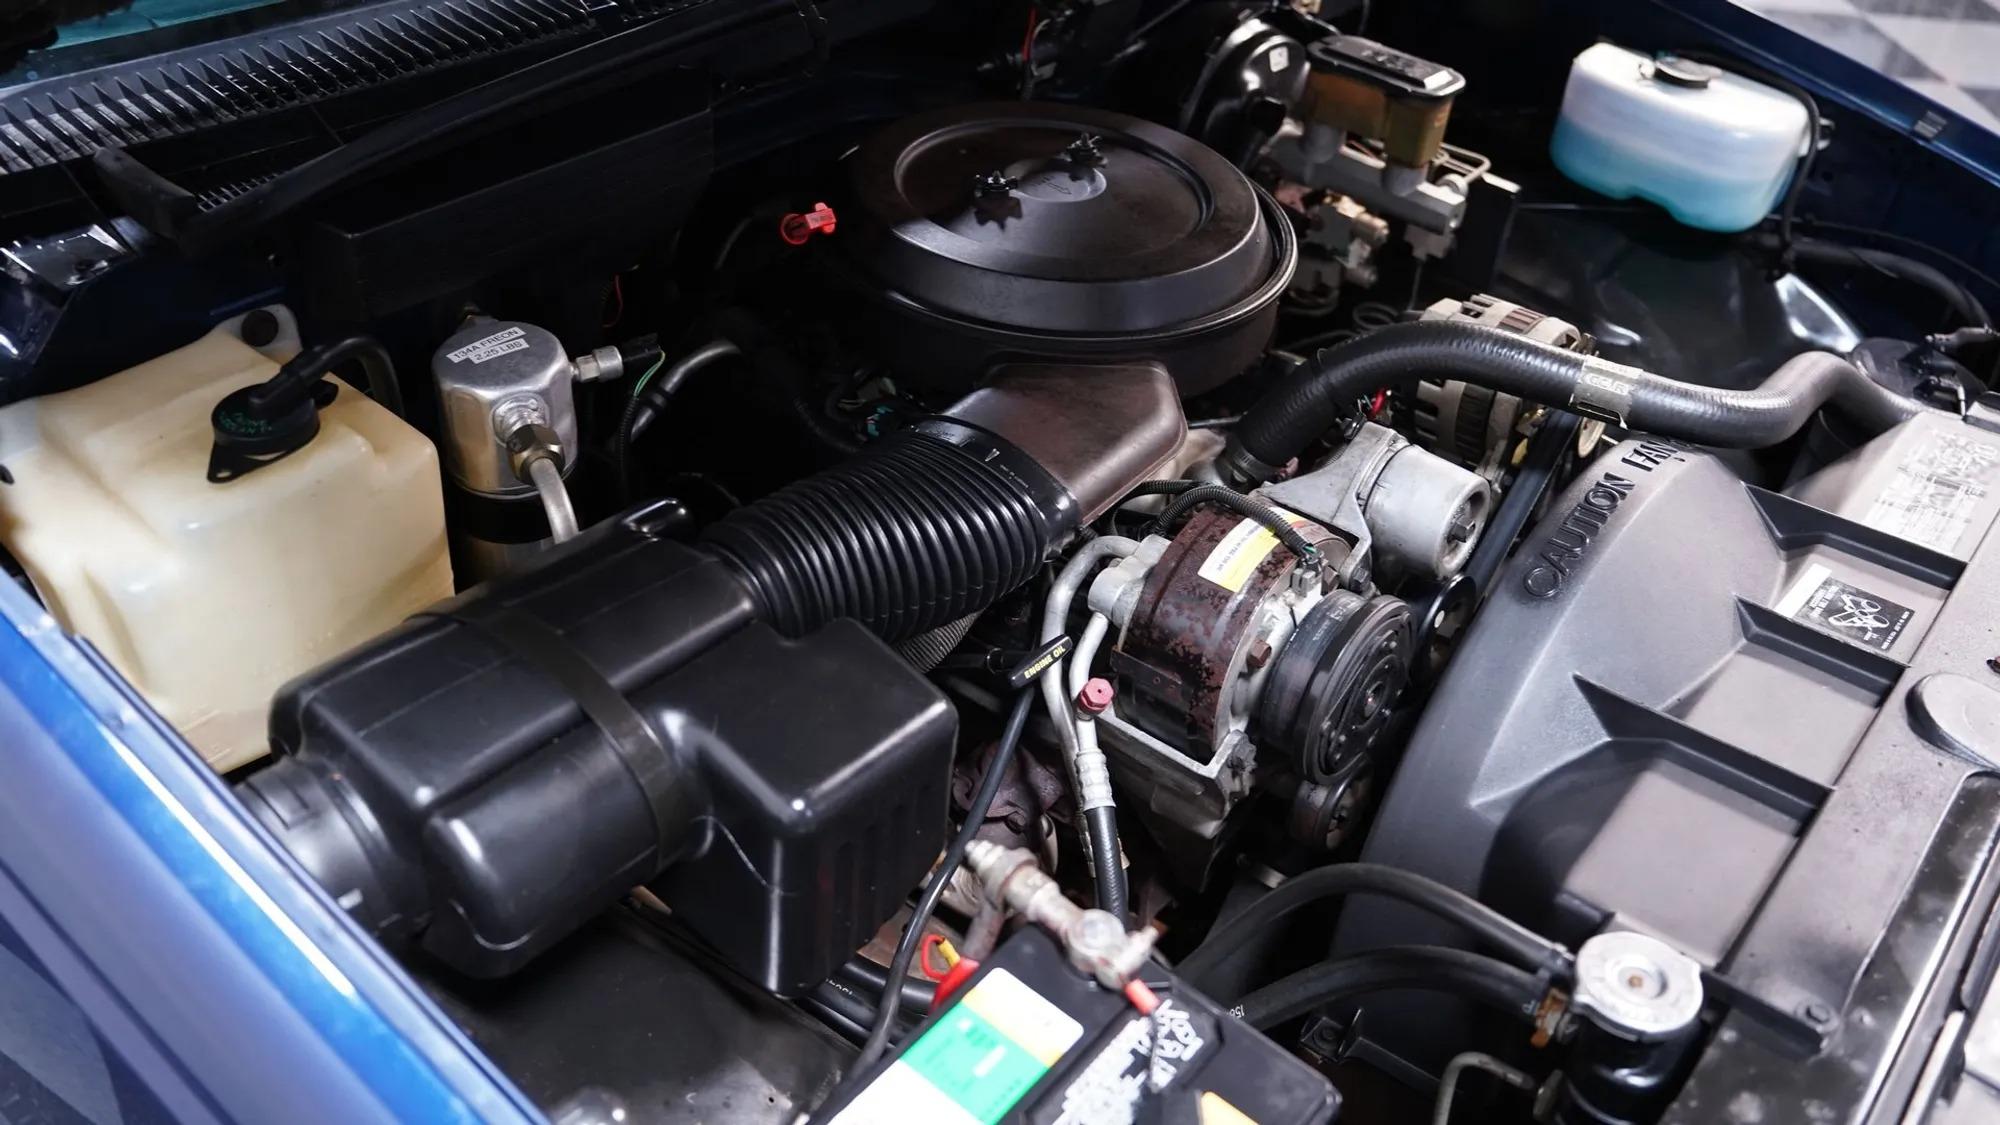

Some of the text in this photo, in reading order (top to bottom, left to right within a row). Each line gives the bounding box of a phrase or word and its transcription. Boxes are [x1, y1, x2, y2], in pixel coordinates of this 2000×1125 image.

[454, 329, 518, 359] 134A FREON
[1523, 472, 1636, 598] CAUTION
[1024, 645, 1066, 679] ENGINE OIL
